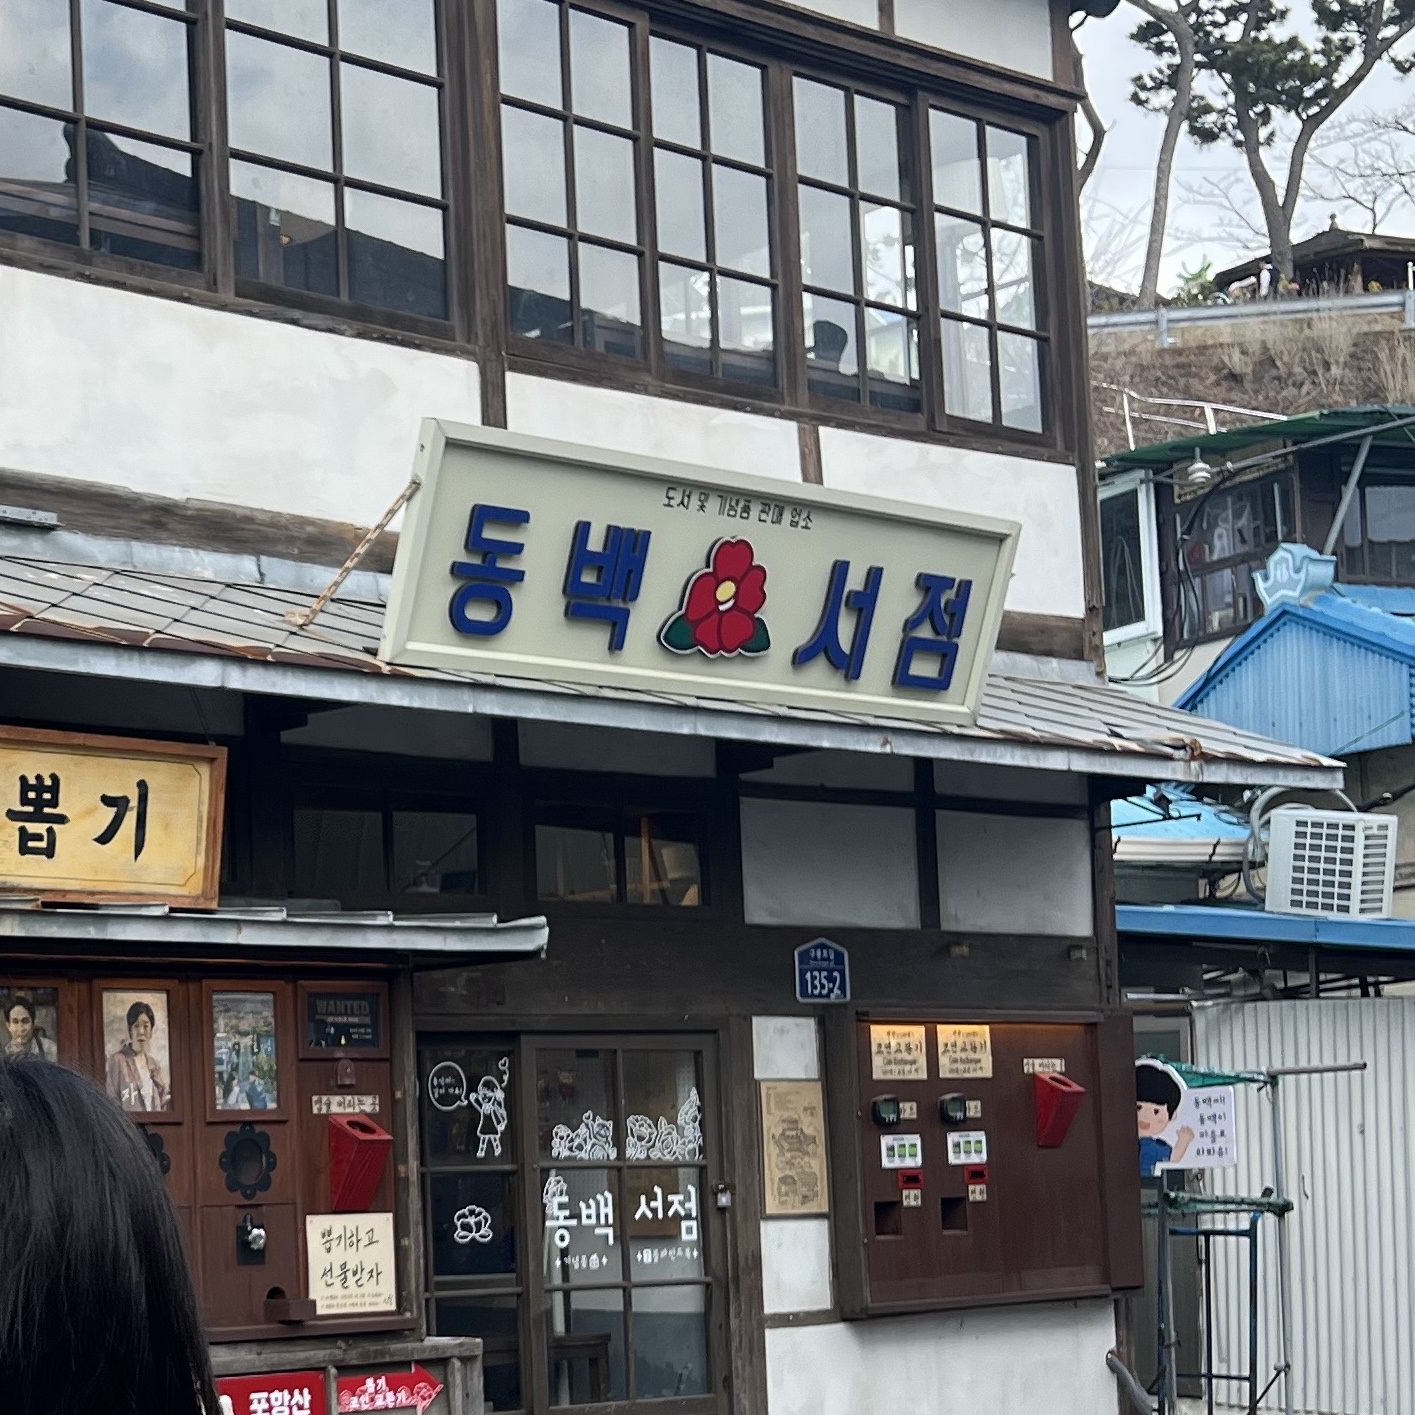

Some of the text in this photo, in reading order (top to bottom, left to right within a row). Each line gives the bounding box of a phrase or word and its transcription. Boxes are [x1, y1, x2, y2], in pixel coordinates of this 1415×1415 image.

[663, 486, 693, 510] 도서
[697, 491, 710, 513] 및
[718, 494, 751, 520] 기념품
[448, 502, 973, 692] 동백 서점
[5, 771, 148, 862] 뽑기
[804, 970, 842, 996] 135-2
[316, 1000, 369, 1014] WANTED
[545, 1184, 698, 1249] 동백 서점
[321, 1224, 380, 1254] 뽑기하고
[320, 1260, 383, 1289] 선물받자
